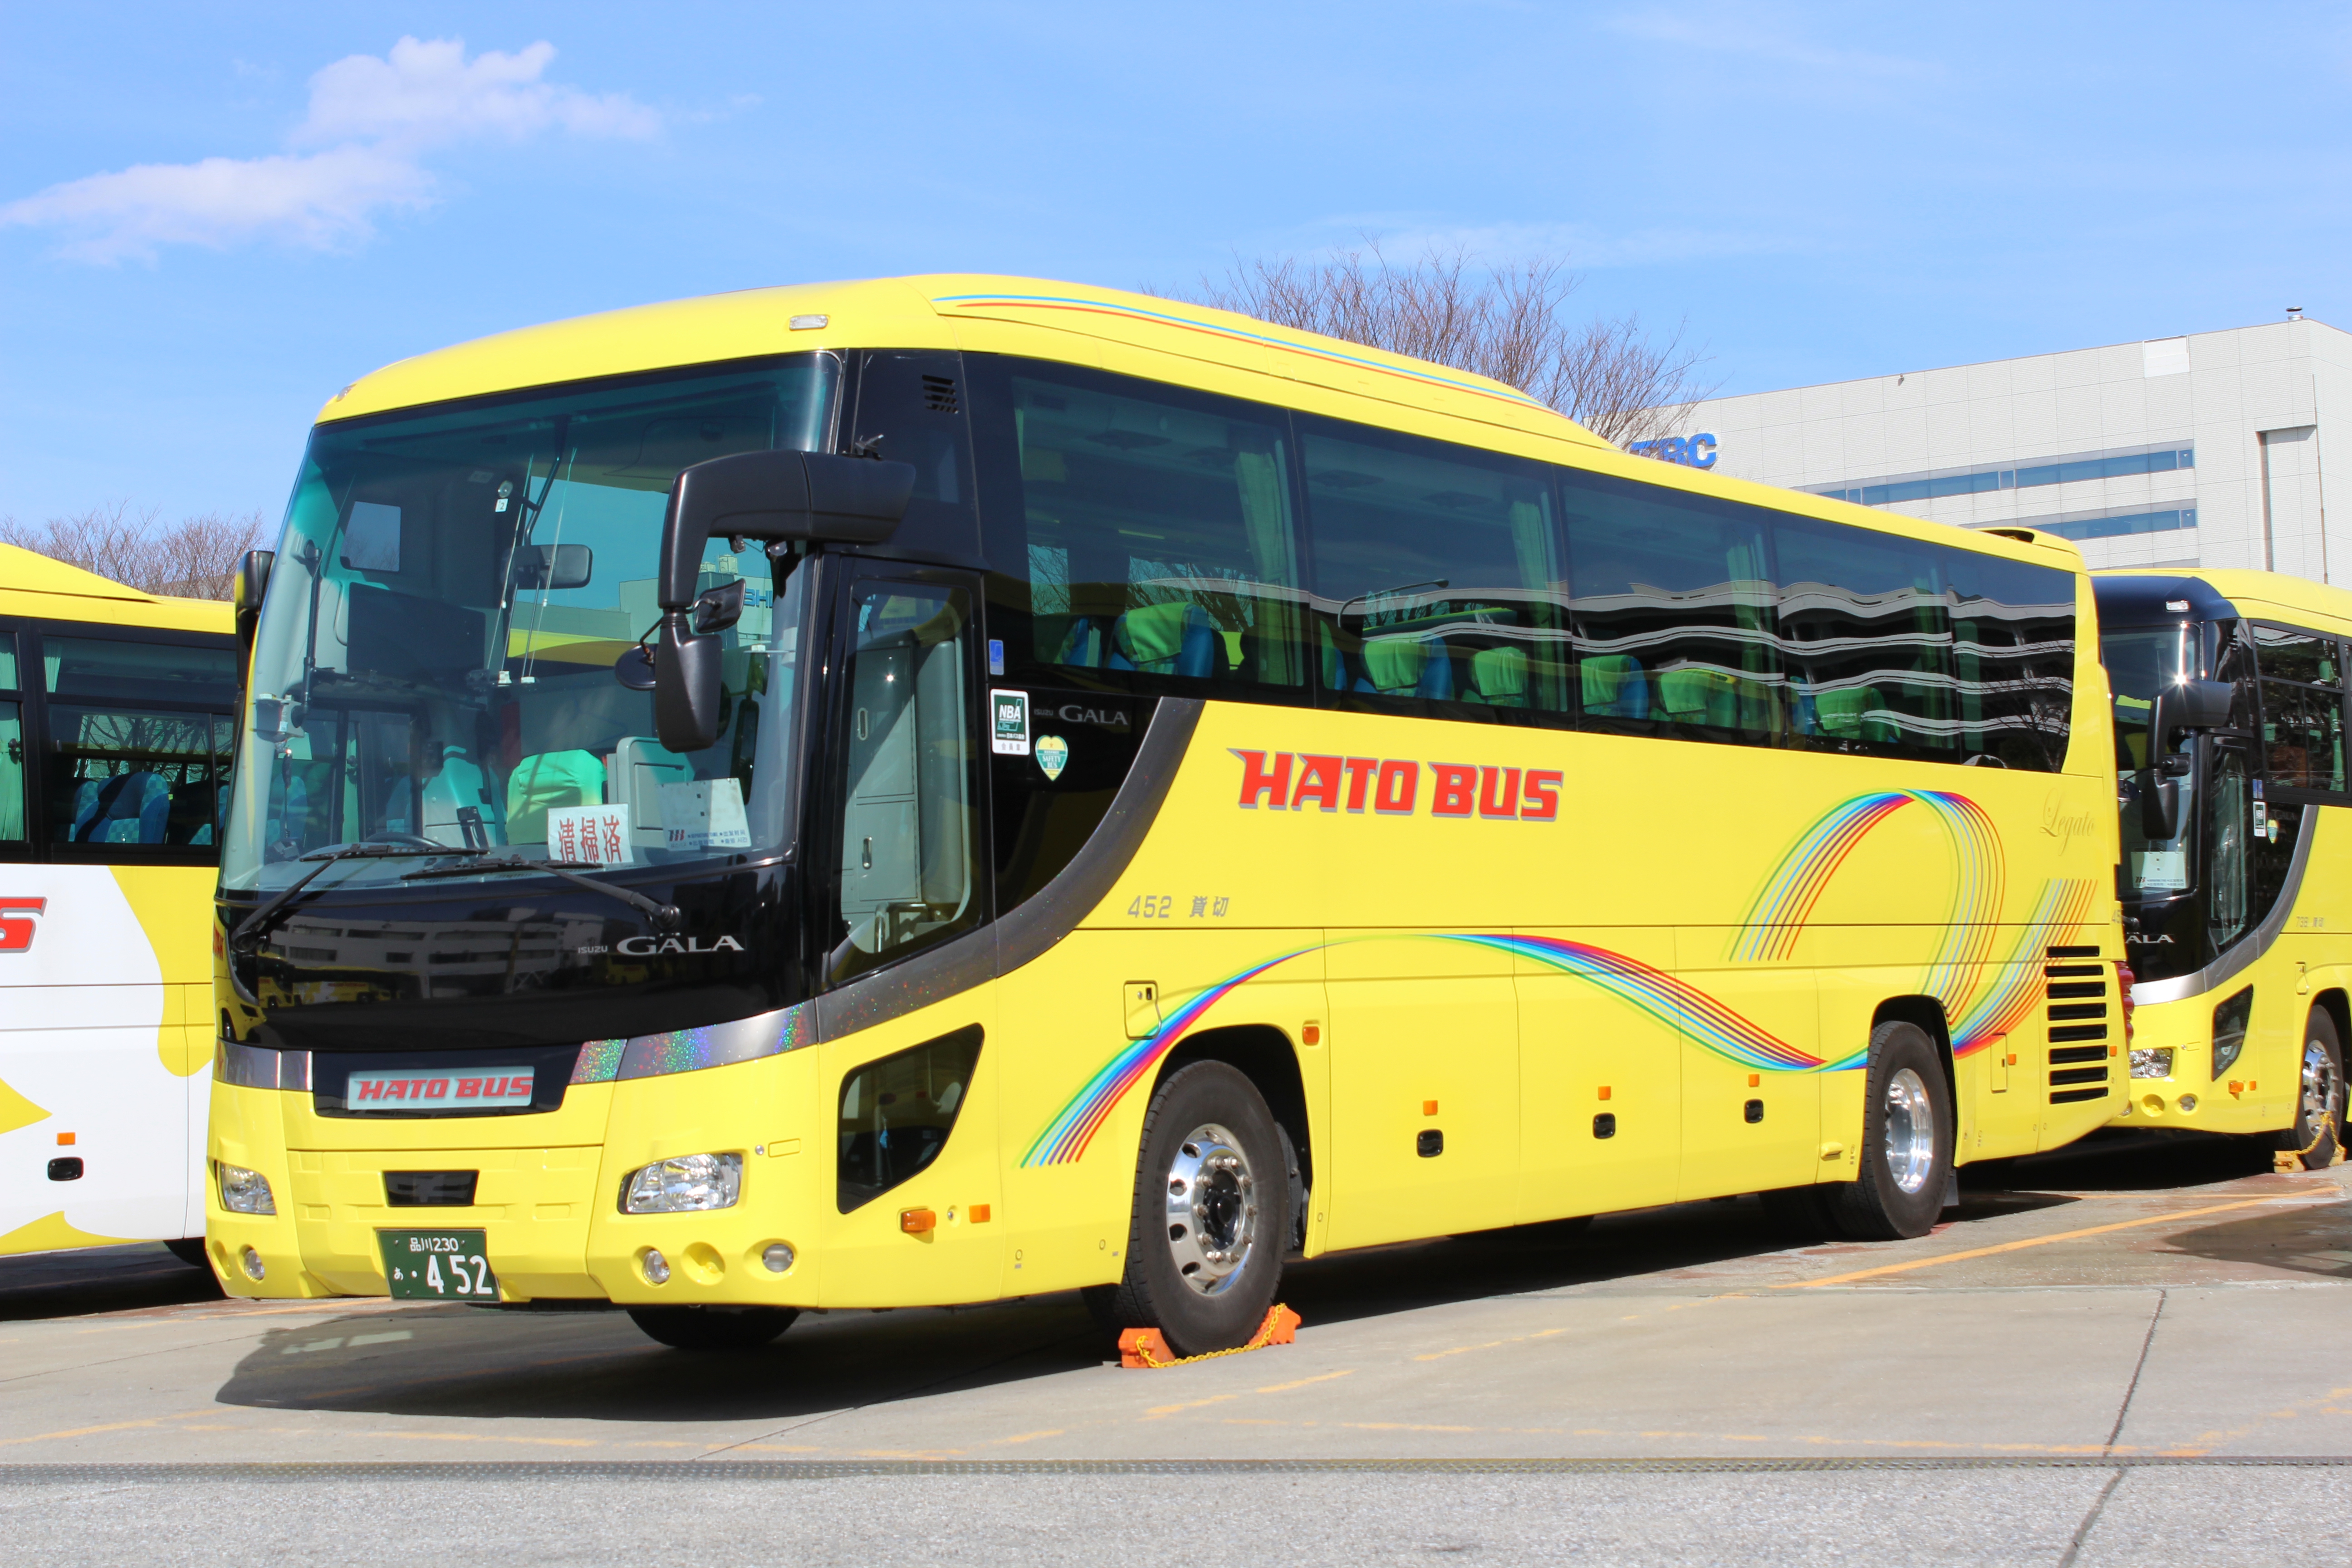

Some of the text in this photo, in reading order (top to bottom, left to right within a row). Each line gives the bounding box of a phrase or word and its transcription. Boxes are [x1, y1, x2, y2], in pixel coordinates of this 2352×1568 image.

[1000, 704, 1021, 719] NBA
[1058, 705, 1128, 725] GALA
[1226, 748, 1564, 822] HATO BUS
[2039, 788, 2095, 857] Legato
[558, 814, 622, 863] 清掃済
[1127, 895, 1230, 918] 452 貸切
[617, 936, 745, 956] GALA
[2125, 935, 2175, 944] ALA
[355, 1076, 534, 1100] HATO BUS
[427, 1254, 493, 1294] 452
